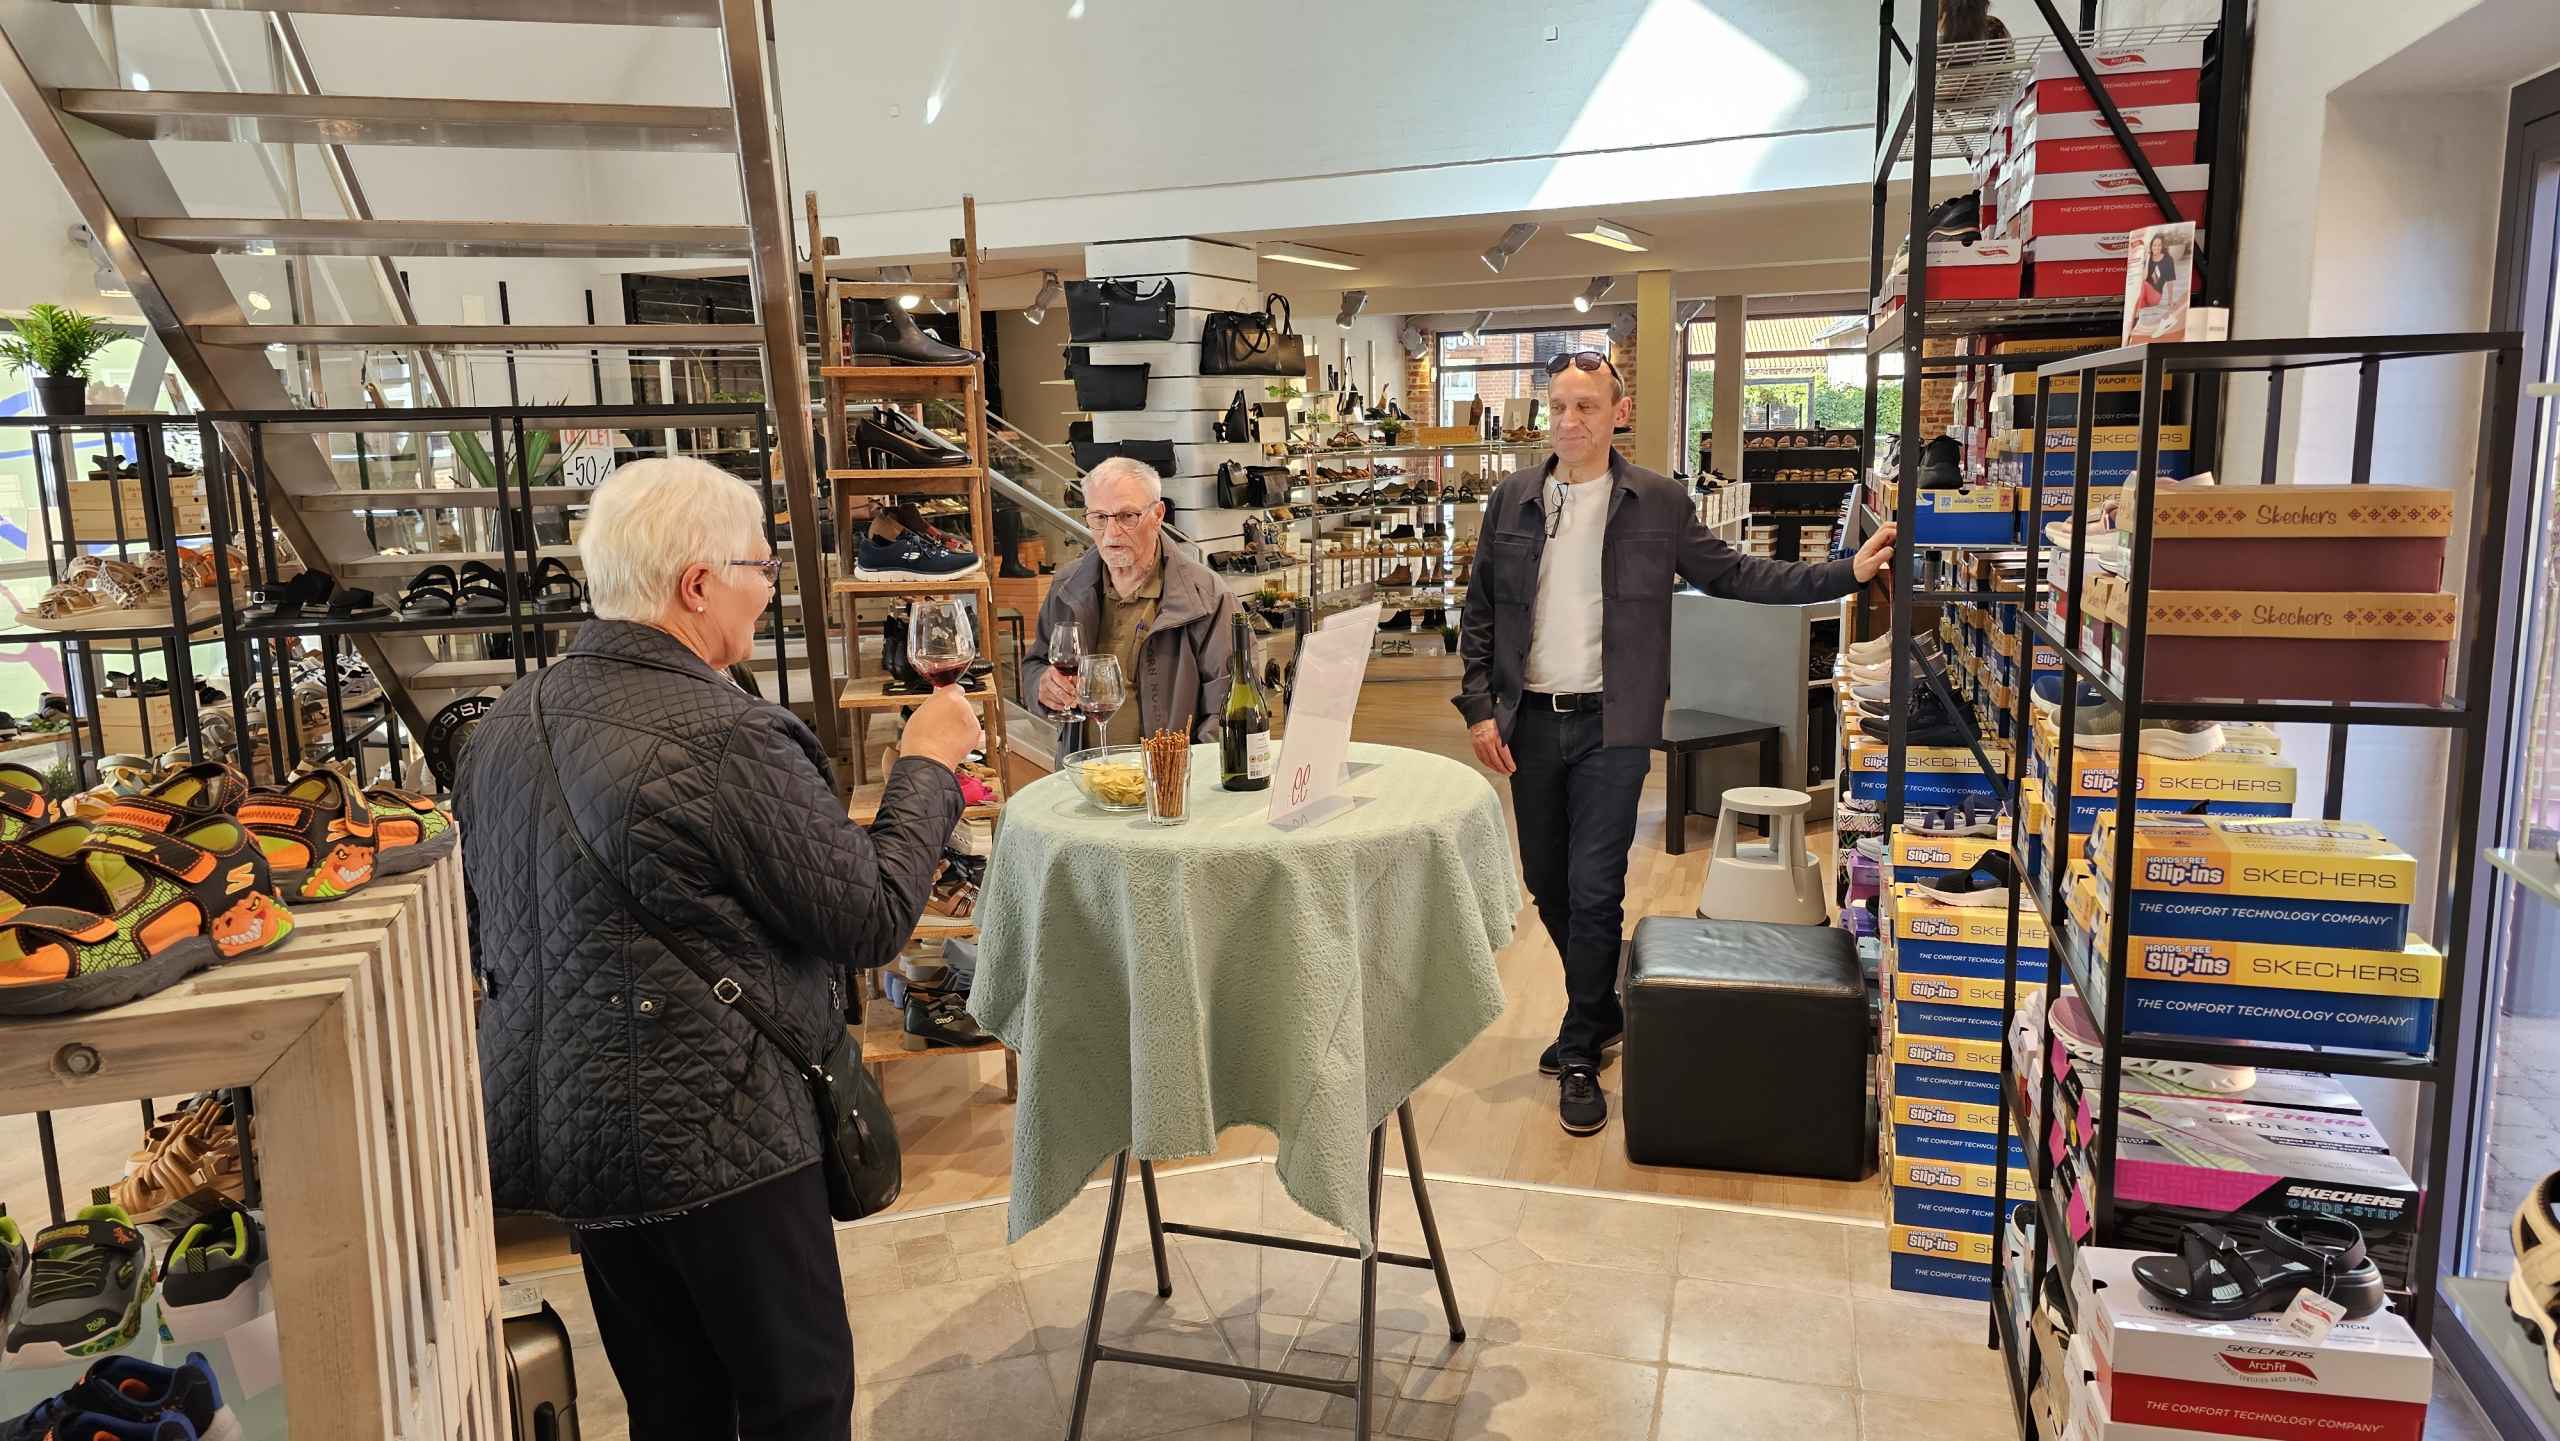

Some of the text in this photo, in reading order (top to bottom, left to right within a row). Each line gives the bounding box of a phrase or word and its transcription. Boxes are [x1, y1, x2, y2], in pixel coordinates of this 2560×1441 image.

[2092, 433, 2183, 444] SKECRS
[2255, 504, 2338, 526] Skechers
[2251, 605, 2333, 627] Skechers
[1907, 757, 2002, 768] SKECHES
[2082, 774, 2282, 793] Slip-s SKECHERS
[2076, 806, 2096, 815] THE
[2147, 863, 2397, 889] Slip-ins SKECHERS
[2139, 902, 2389, 926] THE COMFORT TECHNOLOGY COMPANY
[1912, 921, 1959, 937] Slip-ins
[1968, 956, 2005, 965] TECHNOLO
[2145, 952, 2421, 984] Slip-ins SKECHERS
[1911, 983, 1959, 999] Slip-ins
[2136, 998, 2408, 1027] THE COMFORT TECHNOLOGY COMPANY
[1908, 1047, 1955, 1062] Slip-ins
[1909, 1108, 1955, 1123] Slip-ins
[1911, 1169, 1960, 1186] Slip-ins
[2286, 1185, 2405, 1209] SKECHERS
[1917, 1203, 1931, 1211] THE
[1932, 1205, 1970, 1215] COMFORT
[2288, 1199, 2401, 1221] GLIDE-STEP
[1908, 1235, 1958, 1251] Slip-ins
[1929, 1270, 1967, 1281] COMFORT
[2225, 1344, 2316, 1359] SKECHERS
[2146, 1400, 2380, 1434] THE COMFORT TECHNOLOGY COMPANY
